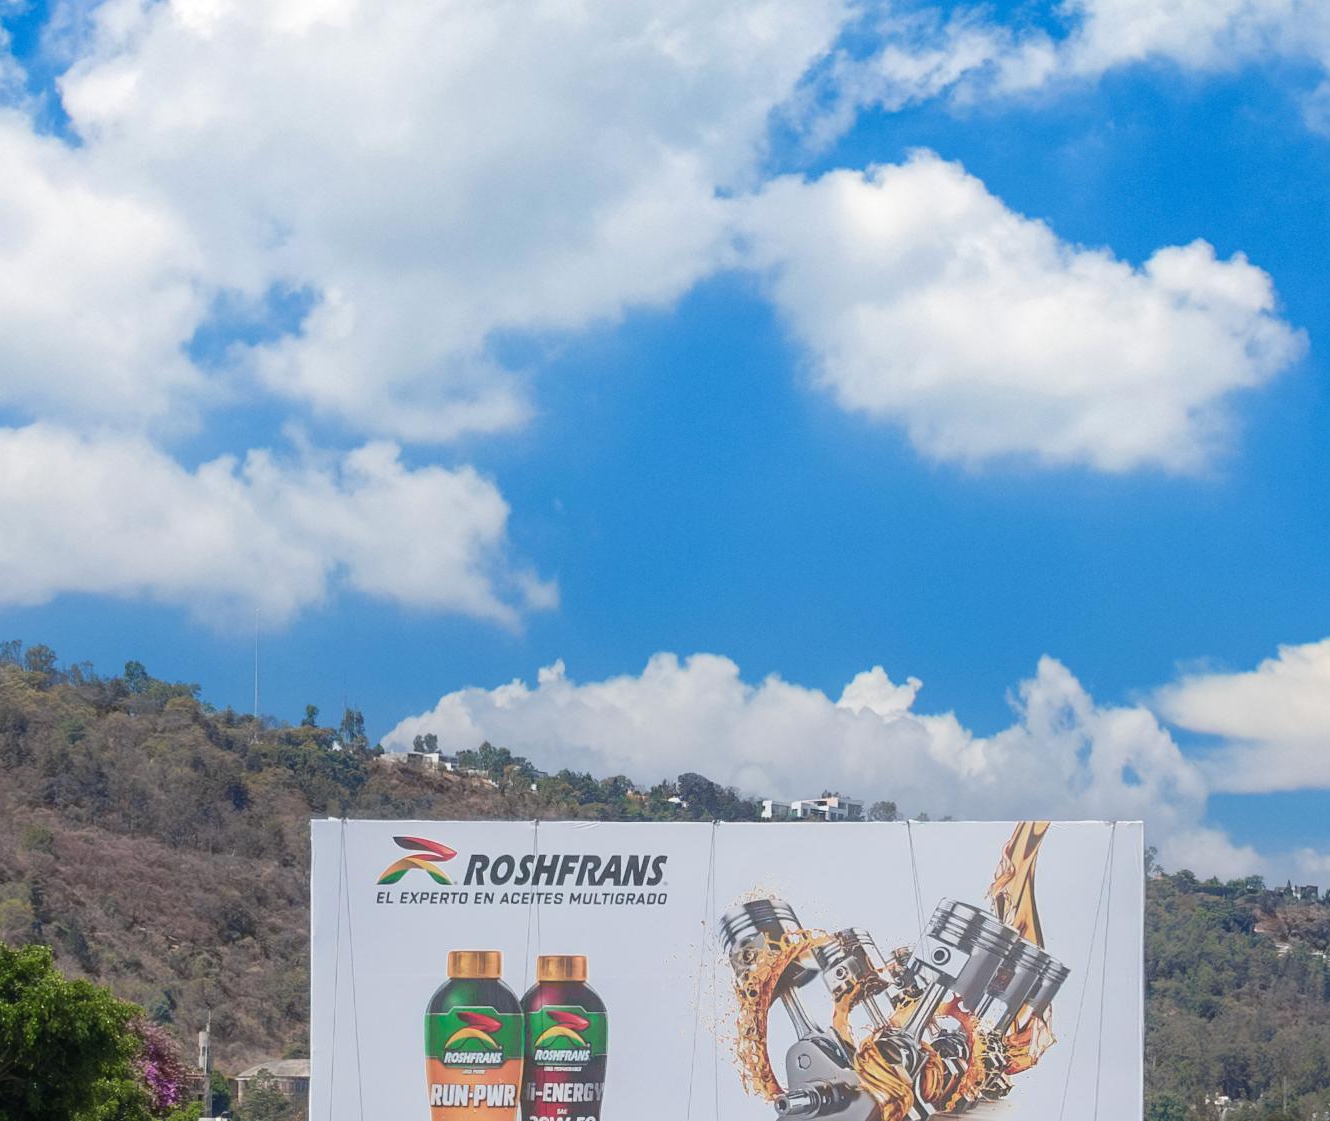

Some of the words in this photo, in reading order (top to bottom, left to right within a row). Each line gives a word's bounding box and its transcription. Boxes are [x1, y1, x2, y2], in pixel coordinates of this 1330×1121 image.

[463, 854, 667, 886] ROSHFRANS
[376, 891, 393, 904] EL
[399, 891, 468, 904] EXPERTO
[473, 892, 494, 904] EN
[499, 892, 564, 905] ACEITES
[569, 892, 667, 905] MULTIGRADO
[443, 1052, 502, 1064] ROSHFRANS
[535, 1049, 590, 1061] ROSHFRANS
